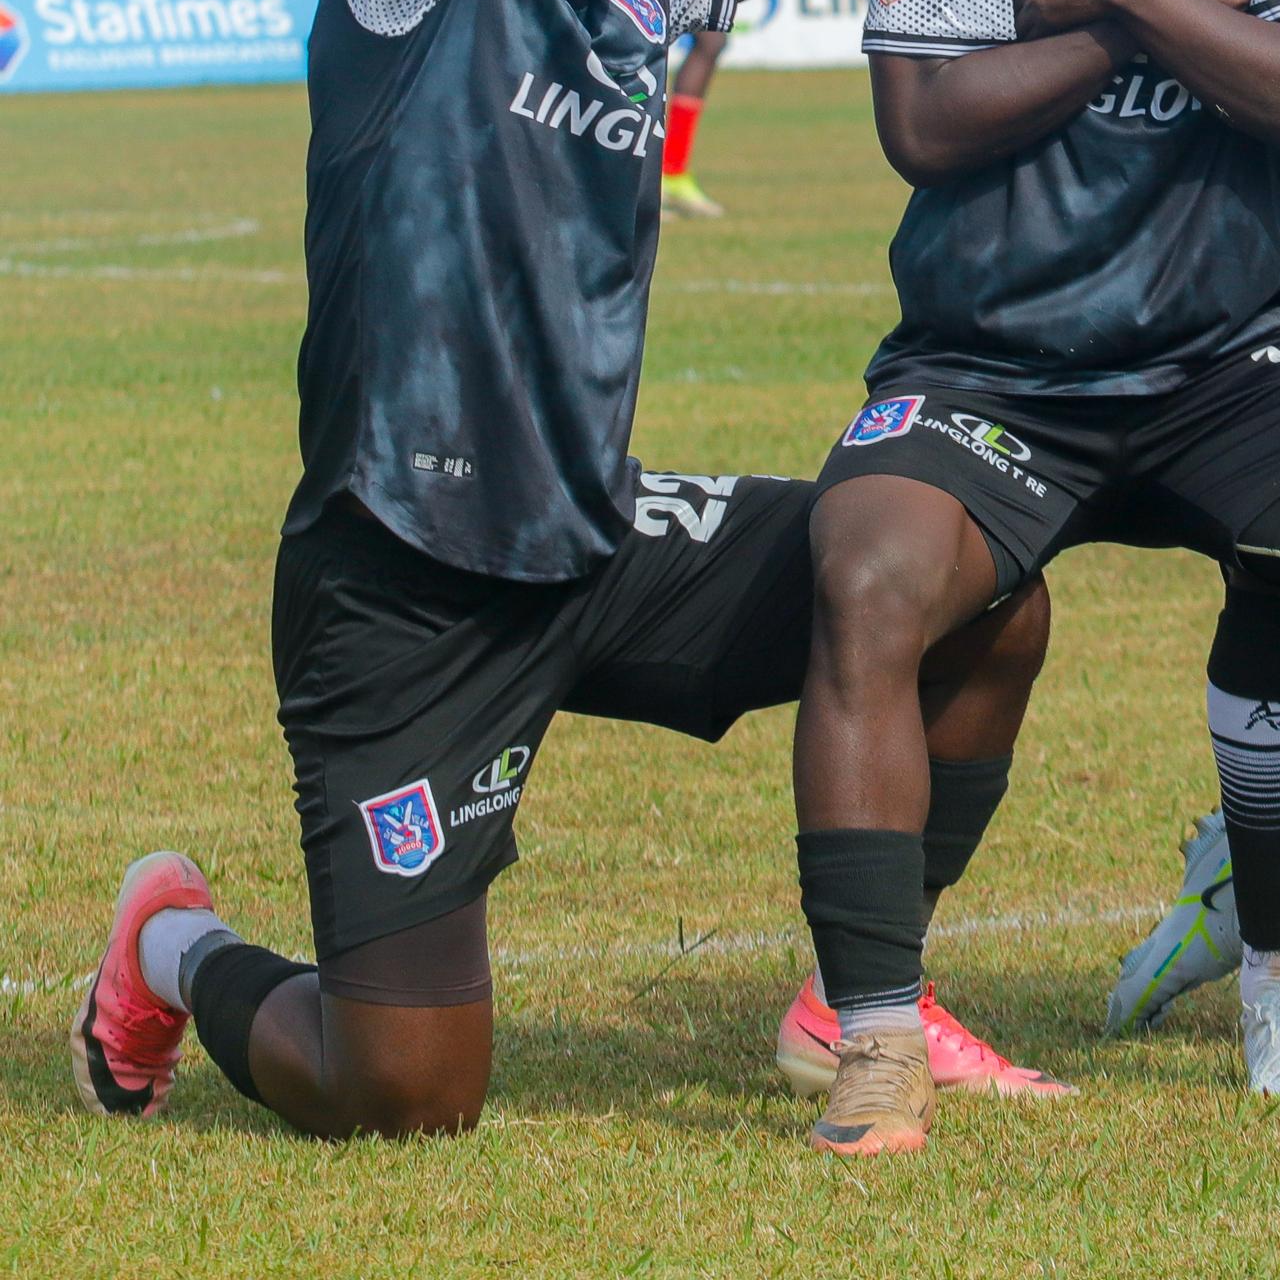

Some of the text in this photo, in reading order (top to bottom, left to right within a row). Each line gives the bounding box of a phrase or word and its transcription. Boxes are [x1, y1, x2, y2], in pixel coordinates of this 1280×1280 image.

[510, 72, 666, 158] LINGL
[912, 414, 1048, 498] LINGLONG TRE
[450, 786, 521, 828] LINGLONG
